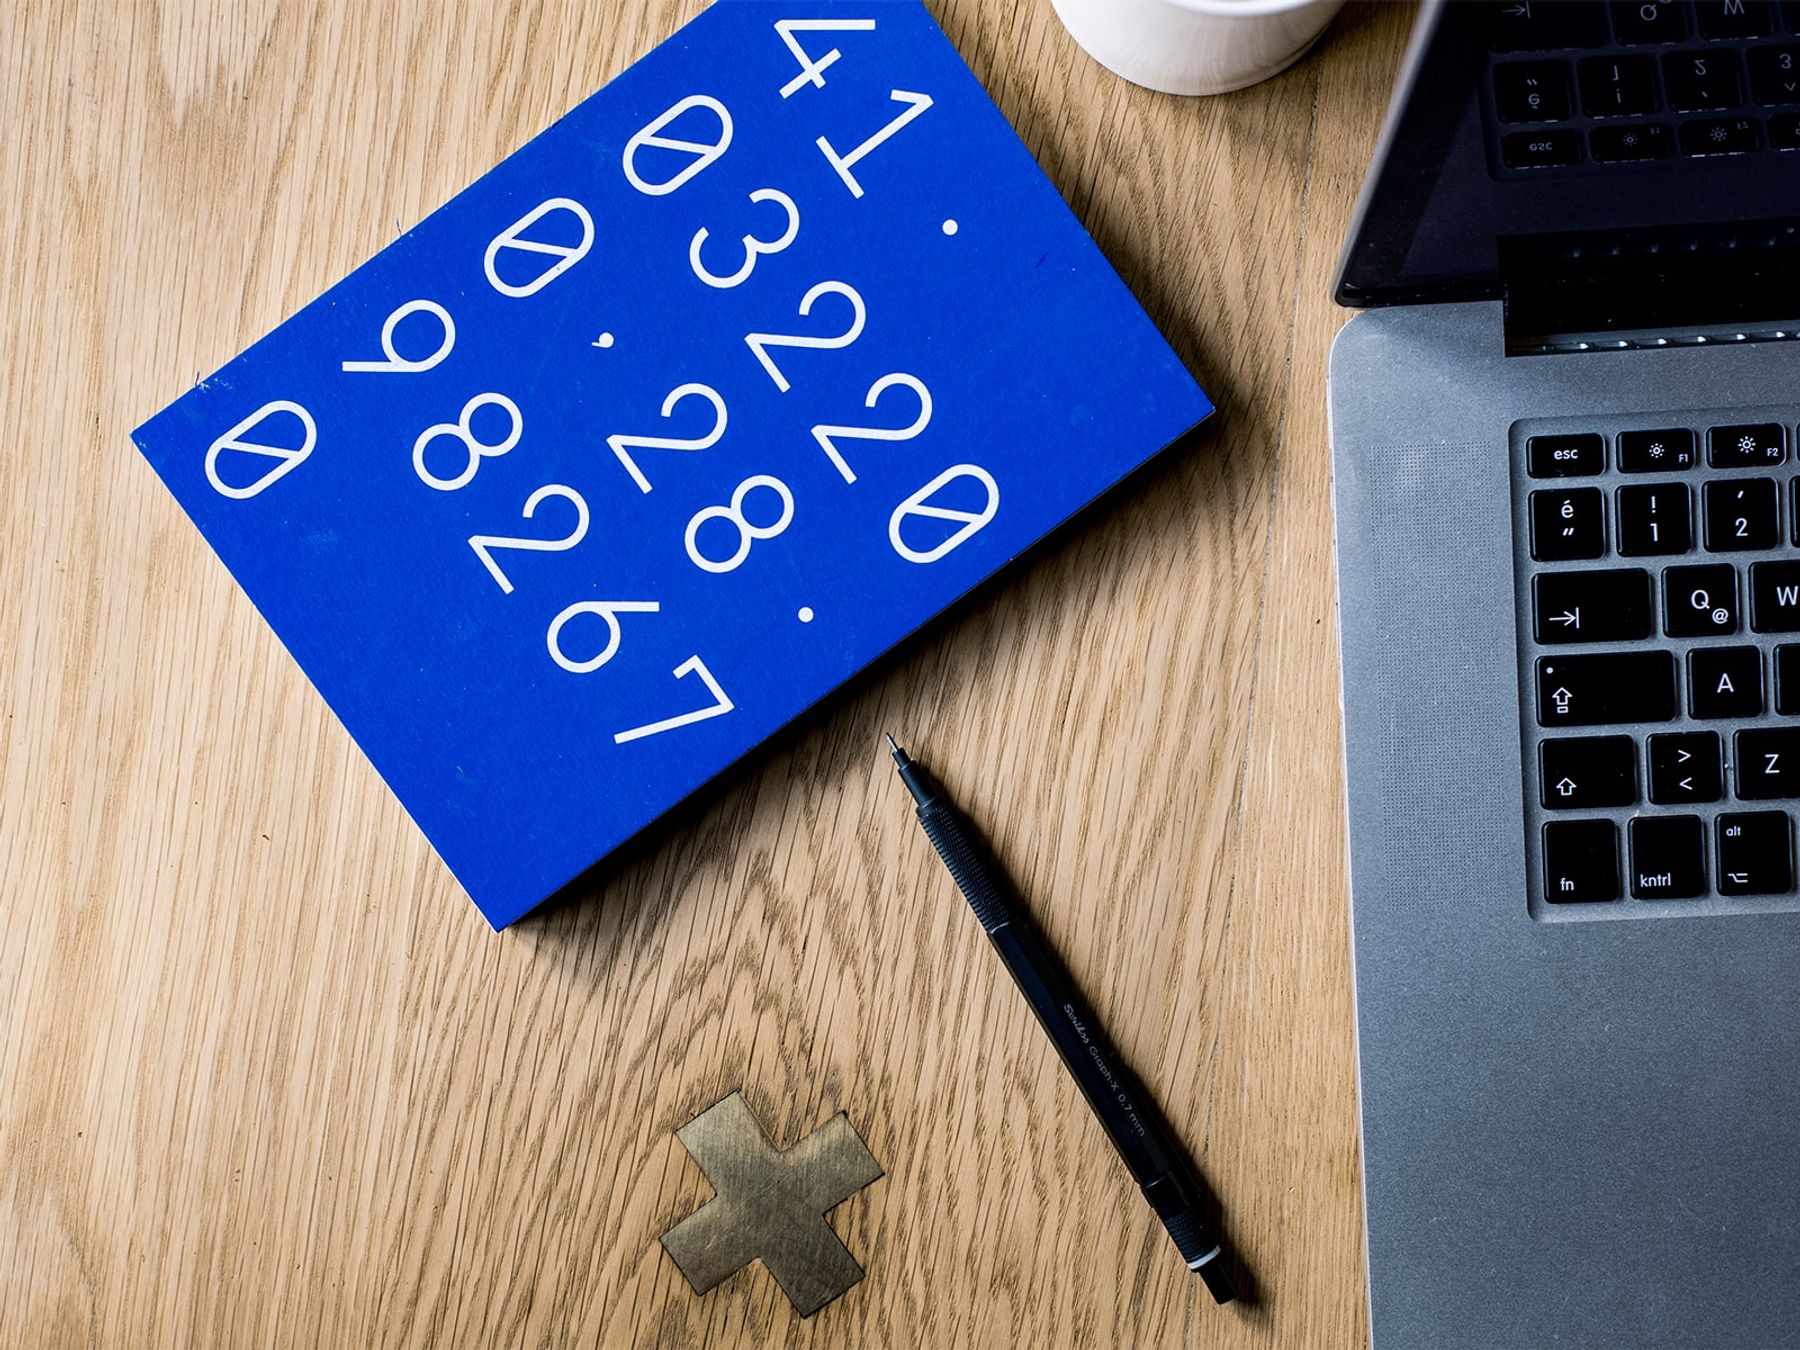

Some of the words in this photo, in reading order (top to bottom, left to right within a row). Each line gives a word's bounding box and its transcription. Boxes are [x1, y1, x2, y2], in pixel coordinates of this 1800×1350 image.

[623, 95, 999, 563] 03220
[205, 401, 316, 499] 0
[1553, 449, 1579, 460] esc
[1678, 453, 1689, 463] F1
[1766, 447, 1779, 457] F2
[1561, 500, 1574, 518] é
[343, 300, 734, 743] 98267
[1735, 518, 1748, 537] 2
[1650, 523, 1658, 542] 1
[1691, 590, 1710, 610] Q
[1776, 586, 1799, 607] W
[1711, 608, 1729, 624] @
[1717, 673, 1735, 693] A
[1765, 754, 1780, 774] Z
[1726, 825, 1742, 837] alt
[1560, 877, 1575, 891] fn
[1640, 872, 1671, 888] kntrl
[1129, 1113, 1146, 1137] mm
